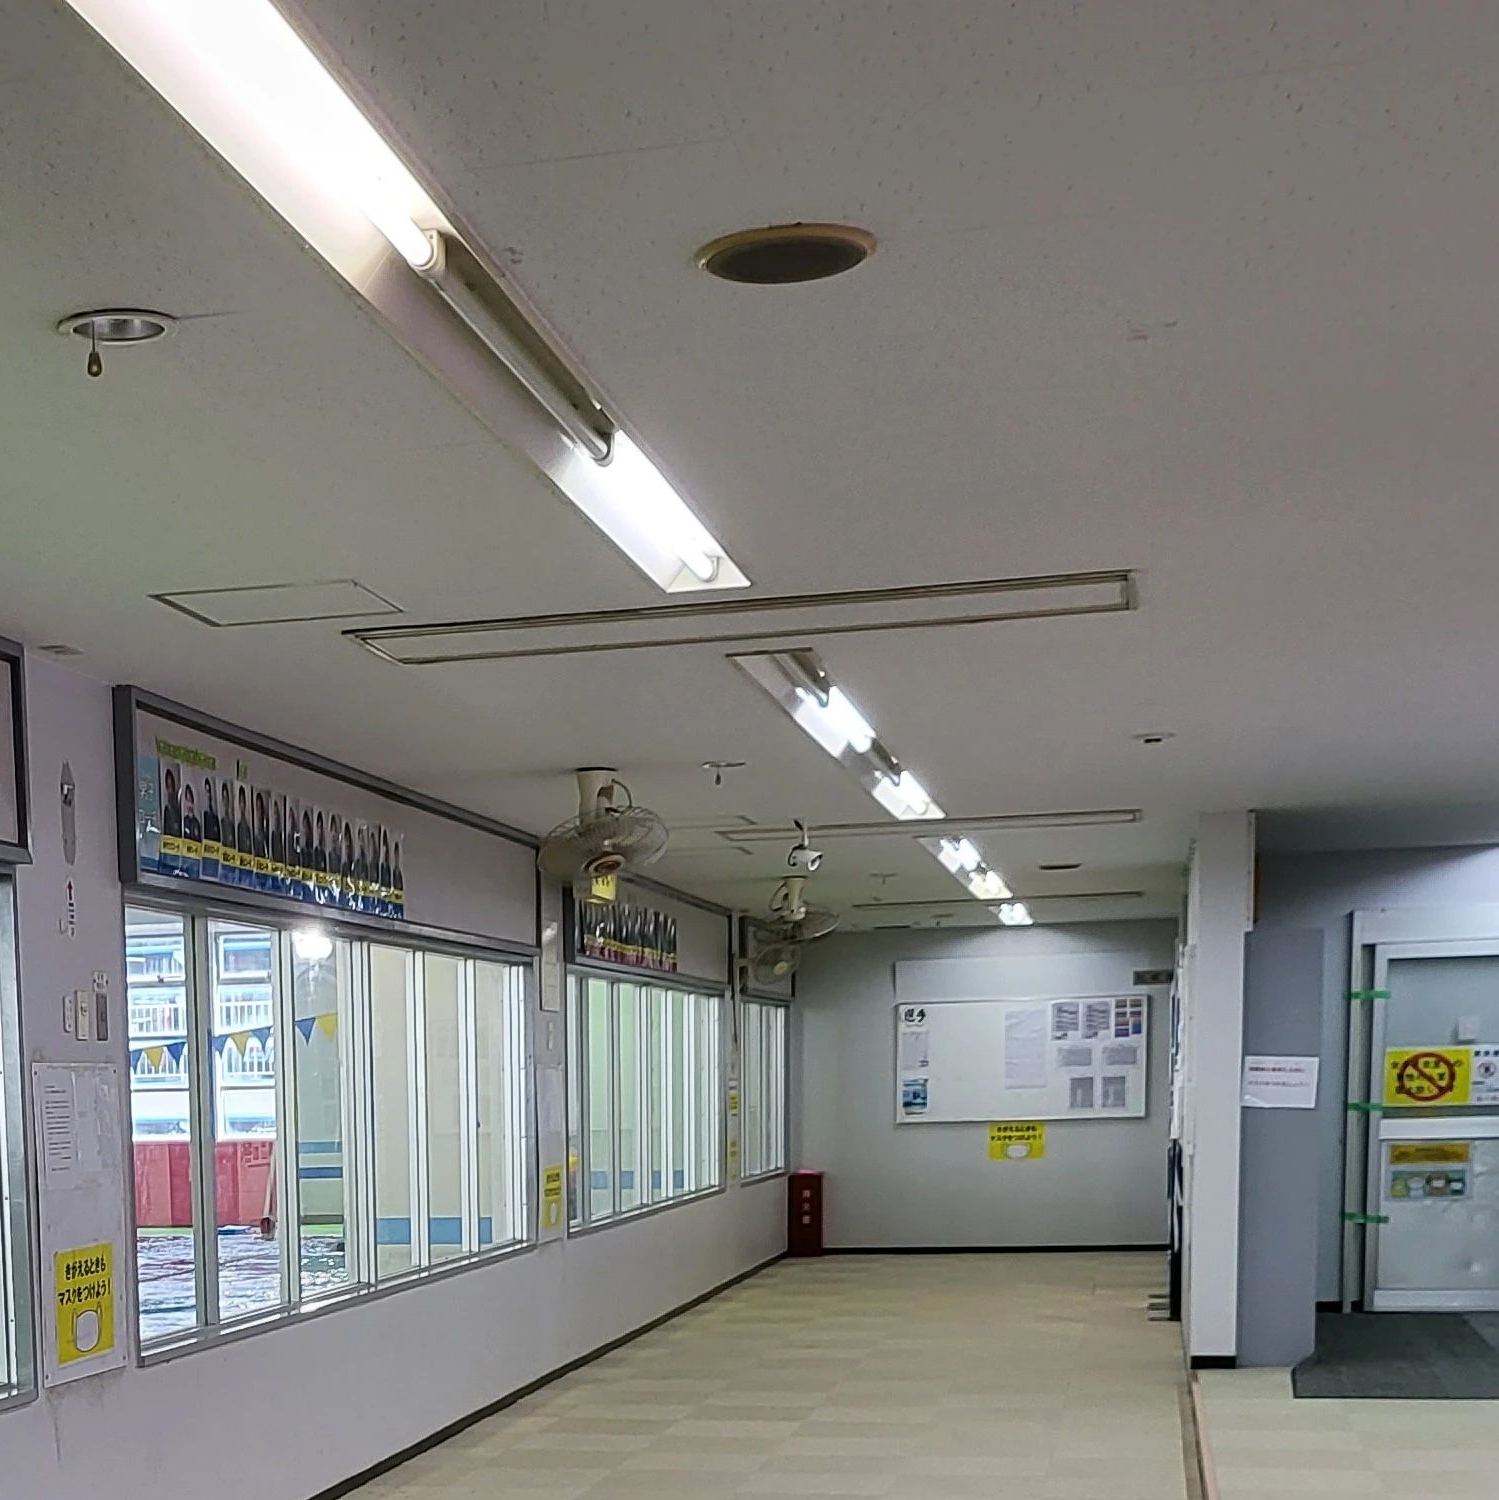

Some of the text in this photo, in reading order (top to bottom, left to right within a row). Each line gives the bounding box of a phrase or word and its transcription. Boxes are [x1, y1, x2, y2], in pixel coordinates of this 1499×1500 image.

[65, 1255, 106, 1281] きがえるときも
